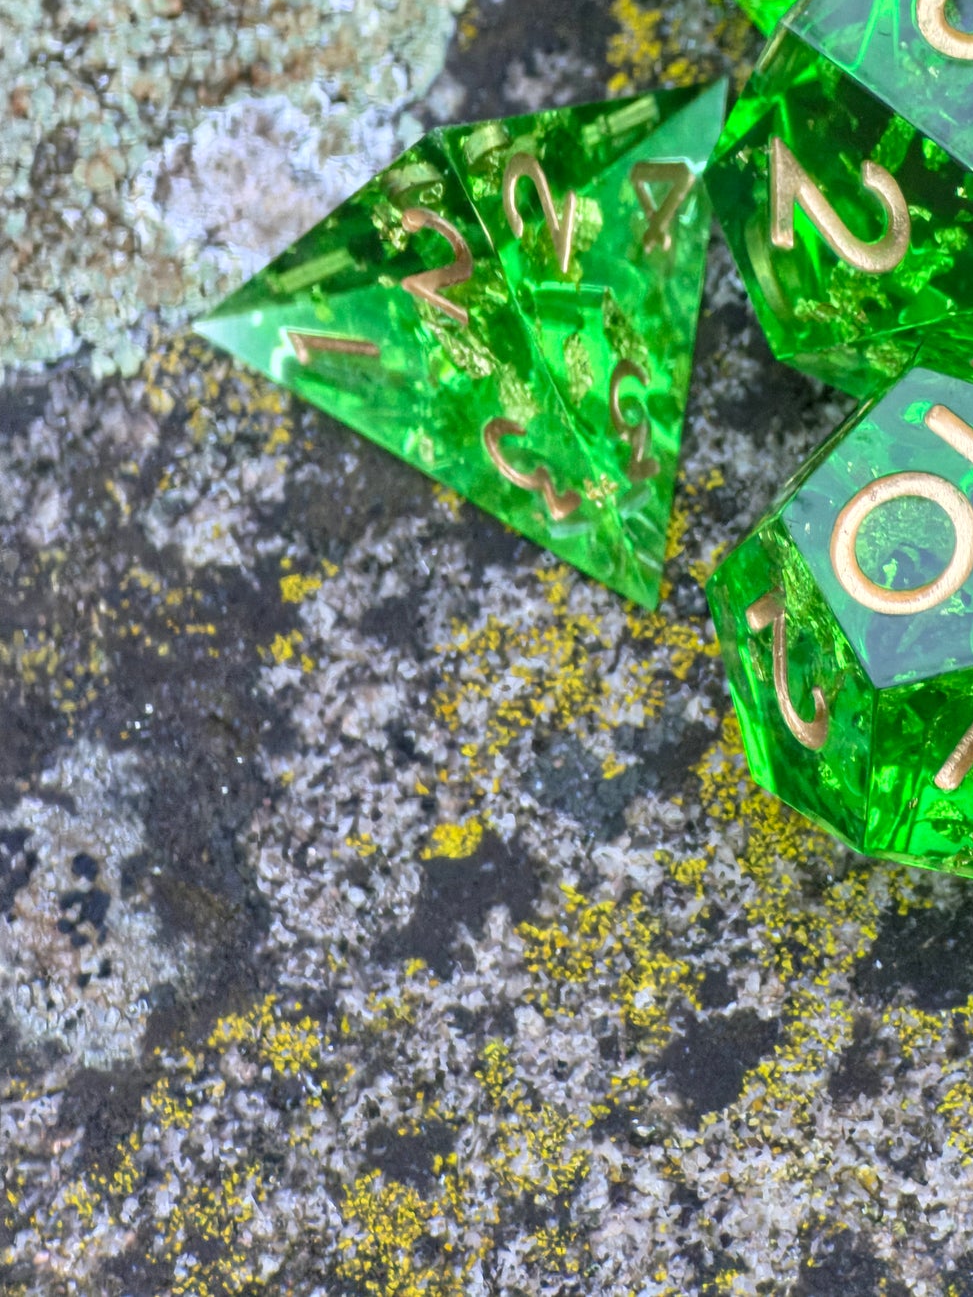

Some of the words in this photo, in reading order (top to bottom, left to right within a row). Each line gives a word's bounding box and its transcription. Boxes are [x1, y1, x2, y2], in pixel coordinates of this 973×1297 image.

[401, 208, 473, 325] 2
[770, 137, 912, 273] 2
[745, 586, 829, 751] 2
